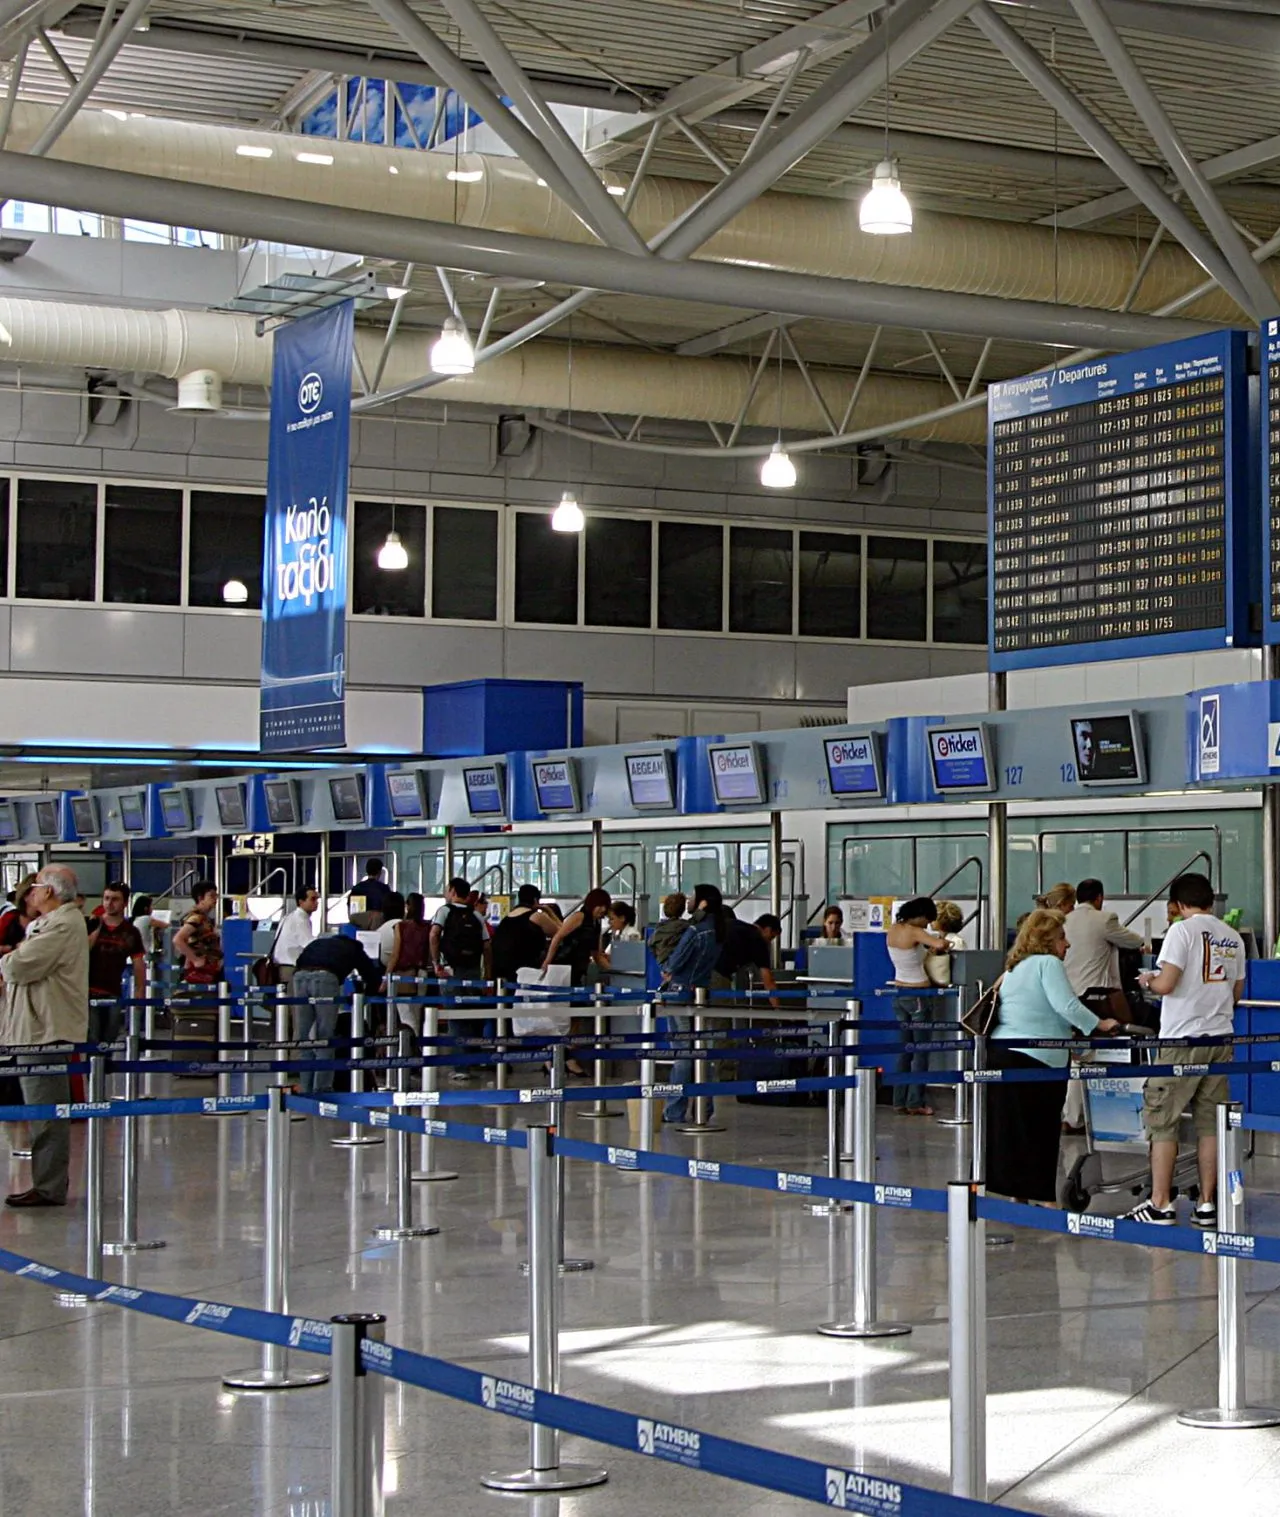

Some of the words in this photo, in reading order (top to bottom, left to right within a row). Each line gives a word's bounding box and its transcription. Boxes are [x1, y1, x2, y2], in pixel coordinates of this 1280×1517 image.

[1059, 363, 1107, 384] Departures
[285, 497, 330, 544] Καλό
[277, 539, 334, 606] ταξίδι
[632, 760, 663, 775] AEGEAN
[469, 773, 495, 786] AEGEAN
[1005, 766, 1023, 785] 127
[531, 1088, 563, 1096] ATHENS
[652, 1084, 683, 1093] ATHENS
[1089, 1080, 1130, 1092] Greece
[71, 1102, 111, 1110] ATHENS
[217, 1096, 256, 1104] ATHENS
[697, 1161, 719, 1172] ATHENS
[787, 1174, 812, 1185] ATHENS
[884, 1185, 911, 1197] ATHENS
[1080, 1215, 1114, 1229] ATHENS
[1217, 1234, 1254, 1247] ATHENS
[301, 1321, 332, 1337] ATHENS
[360, 1338, 393, 1361] ATHENS
[495, 1381, 534, 1404] ATHENS
[654, 1424, 700, 1449] ATHENS
[846, 1474, 901, 1503] ATHENS
